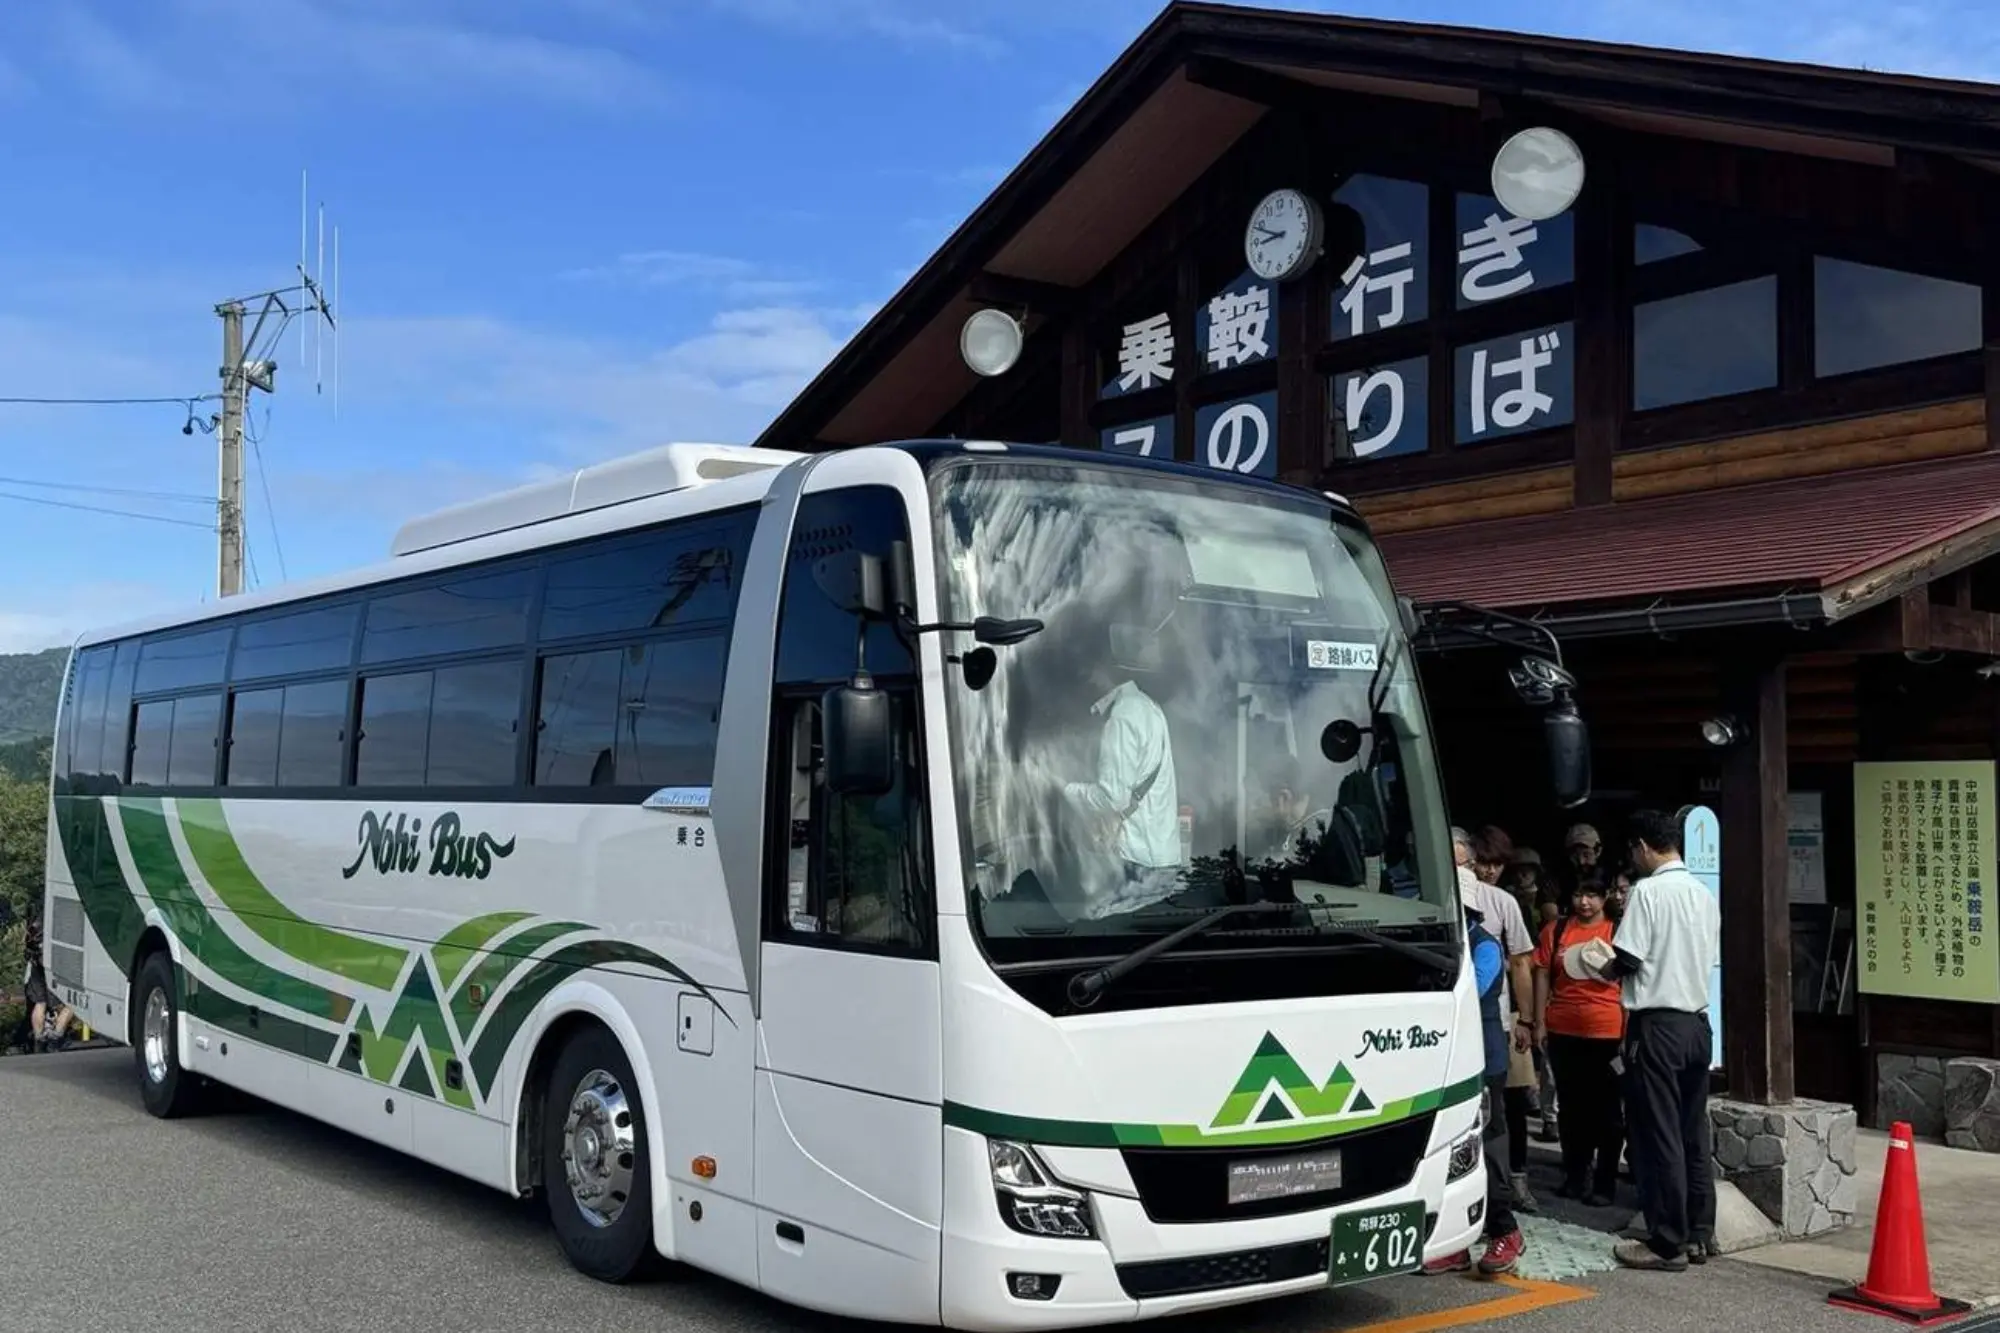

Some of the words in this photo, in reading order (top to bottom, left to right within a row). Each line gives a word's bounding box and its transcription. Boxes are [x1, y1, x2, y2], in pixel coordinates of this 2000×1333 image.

[1118, 213, 1539, 391] 乗鞍行き
[1327, 646, 1376, 666] 路線バス
[342, 810, 422, 879] Nohi
[429, 810, 516, 880] Bus
[1354, 1028, 1403, 1059] Nohi
[1406, 1024, 1448, 1049] Bus
